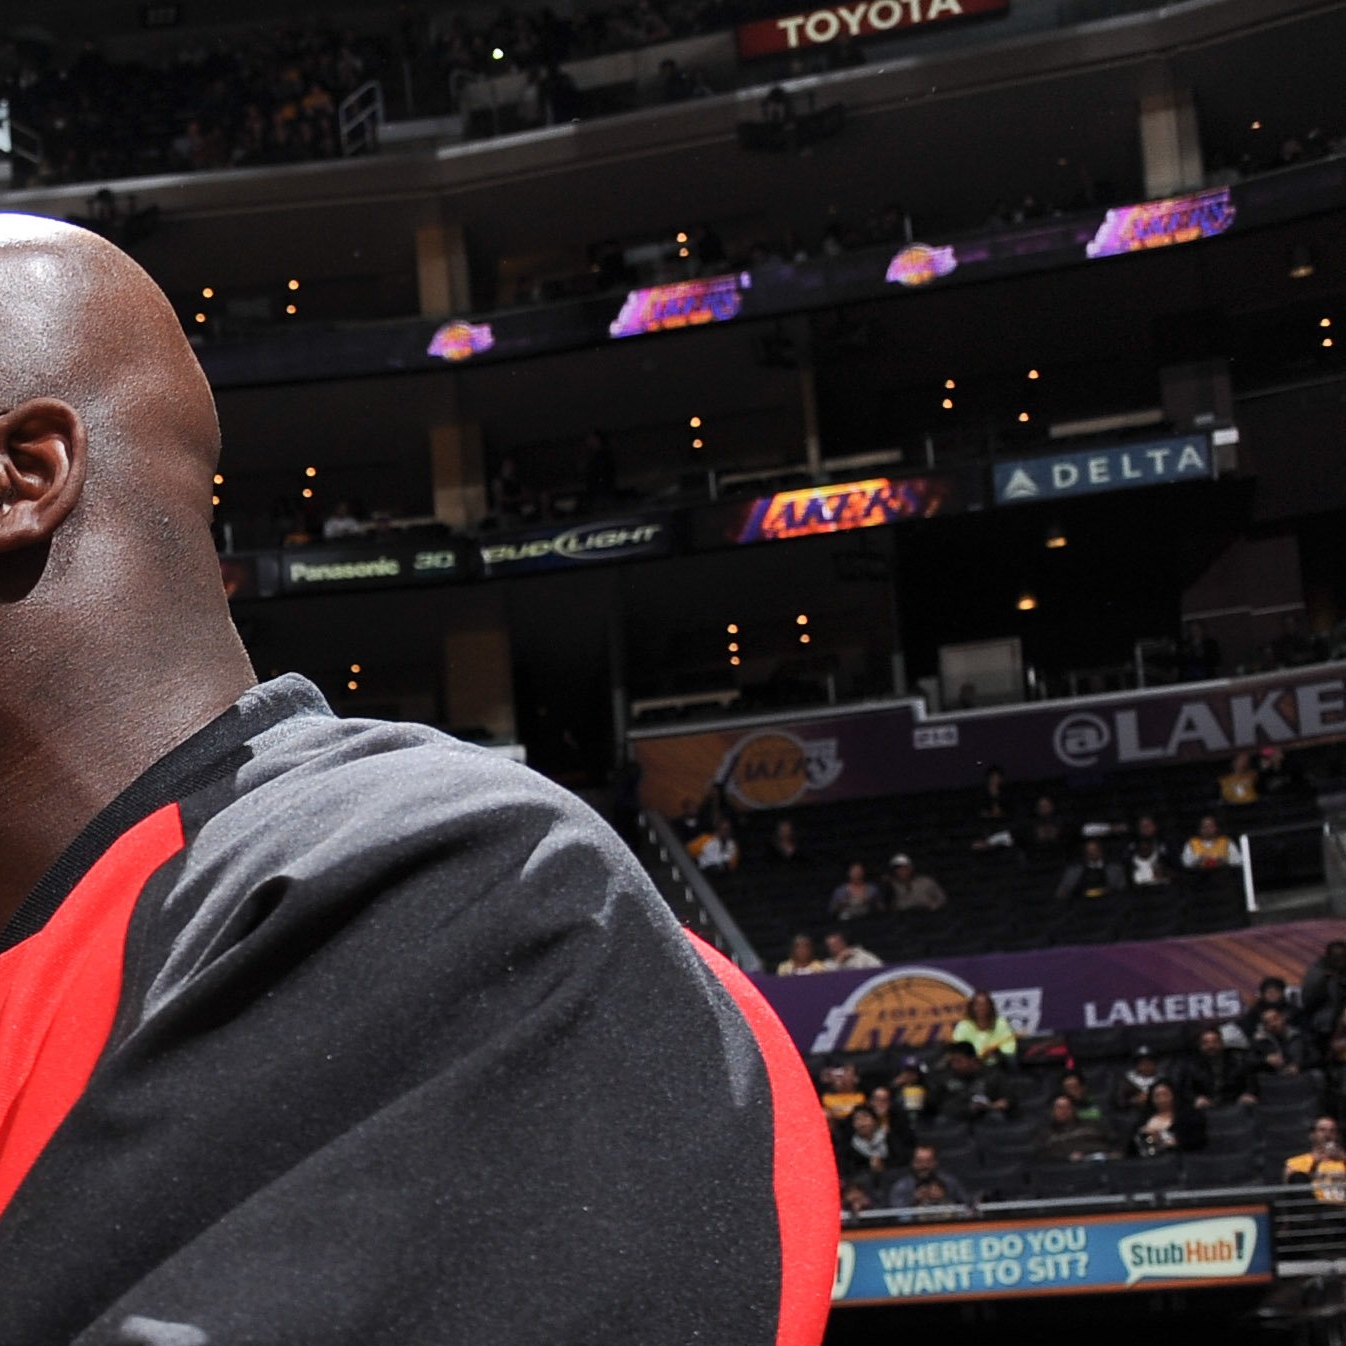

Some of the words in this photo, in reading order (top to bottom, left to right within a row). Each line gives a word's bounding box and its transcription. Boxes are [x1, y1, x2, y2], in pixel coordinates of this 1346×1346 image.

[777, 0, 963, 48] TOYOTA
[1051, 444, 1205, 490] DELTA
[482, 539, 554, 563] BUD
[566, 524, 663, 552] LIGHT
[289, 555, 401, 581] Panasonic
[1083, 989, 1242, 1029] LAKERS
[879, 1241, 976, 1271] WHERE
[979, 1232, 1023, 1261] DO
[1027, 1227, 1087, 1255] YOU
[1130, 1231, 1245, 1266] StubHub!
[883, 1267, 975, 1297] WANT
[977, 1262, 1024, 1288] TO
[1027, 1252, 1090, 1283] SIT?
